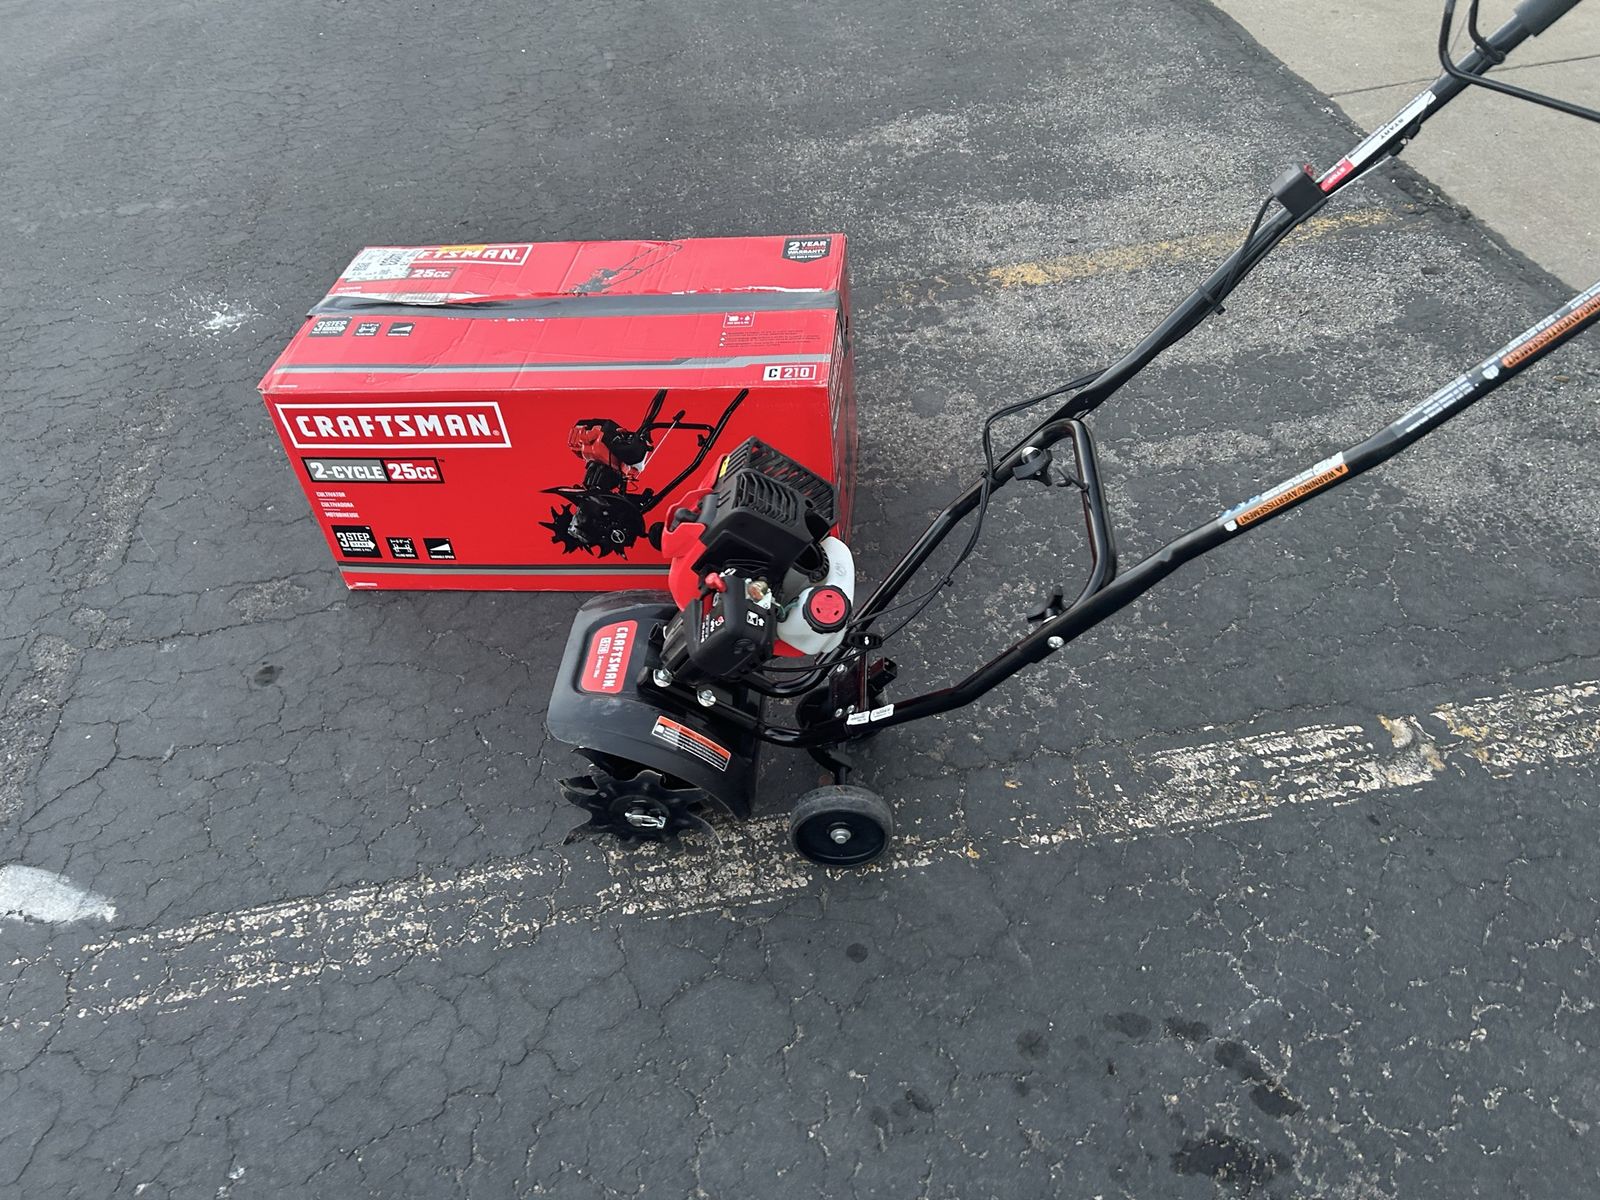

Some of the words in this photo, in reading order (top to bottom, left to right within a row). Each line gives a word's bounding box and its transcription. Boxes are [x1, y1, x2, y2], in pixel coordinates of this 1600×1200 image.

[788, 241, 800, 251] 2
[416, 249, 518, 260] FTSMAN
[325, 320, 348, 328] STEP
[295, 414, 492, 438] CRAFTSMAN
[310, 462, 385, 479] 2-CYCLE
[1240, 471, 1337, 524] WARNING/AVERTISSEMENT
[336, 532, 349, 547] 3
[345, 532, 370, 541] STEP
[602, 626, 629, 687] CRAFTSMAN
